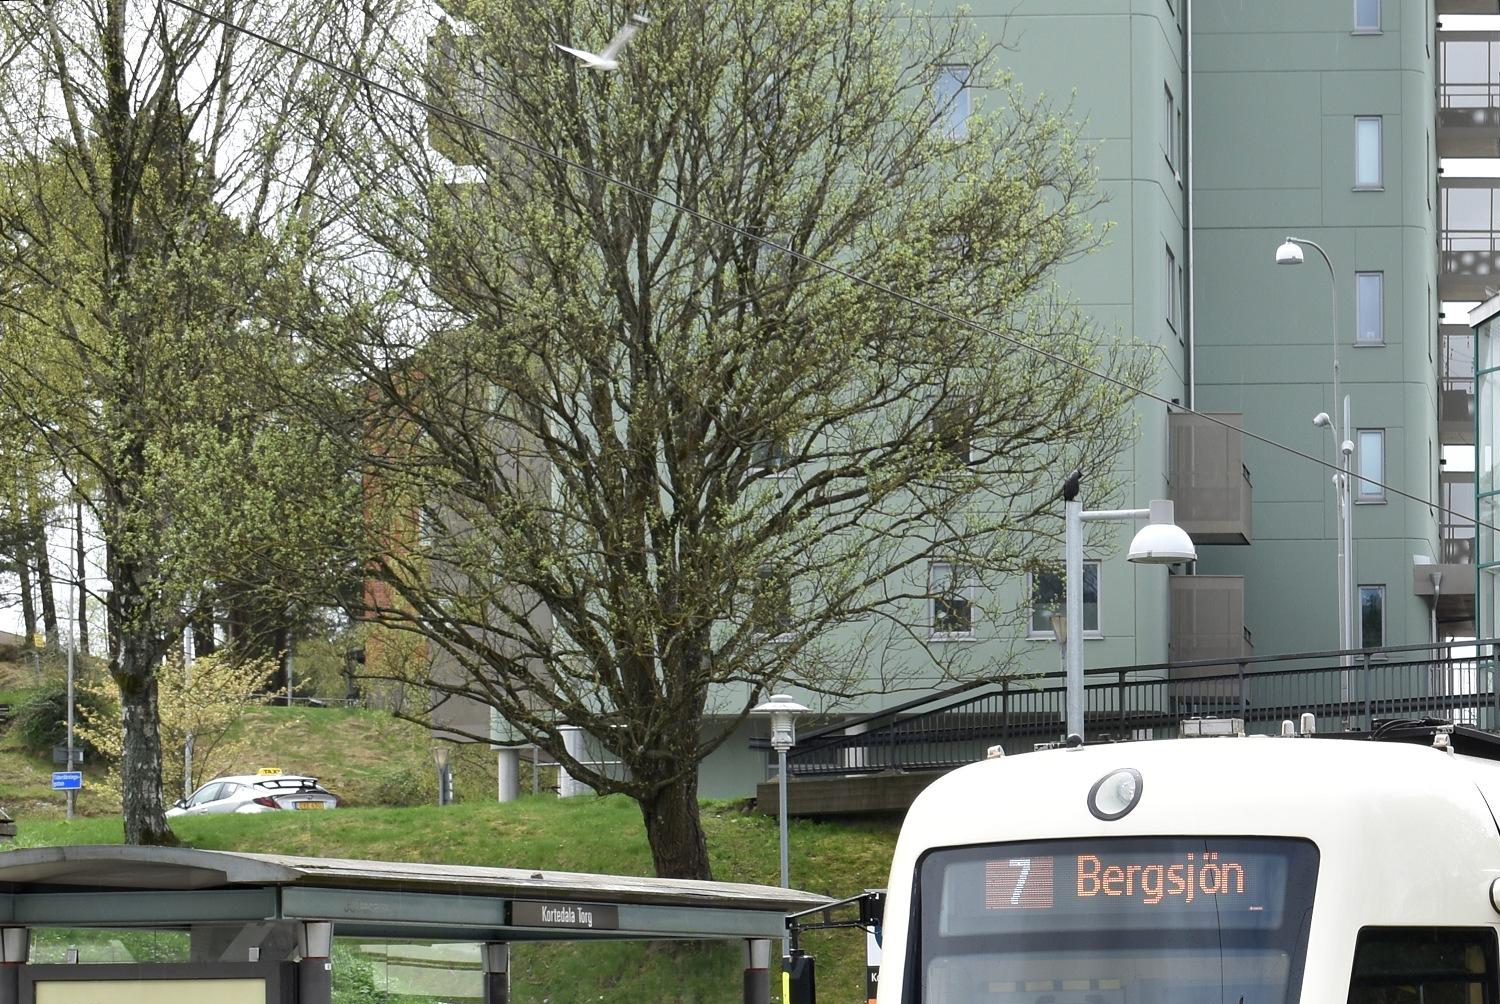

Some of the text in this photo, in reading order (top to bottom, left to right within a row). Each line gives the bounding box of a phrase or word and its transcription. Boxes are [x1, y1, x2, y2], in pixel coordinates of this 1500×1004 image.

[1008, 857, 1031, 905] 7
[1076, 852, 1245, 904] Bergsjön
[541, 905, 593, 928] Kortedala Torg
